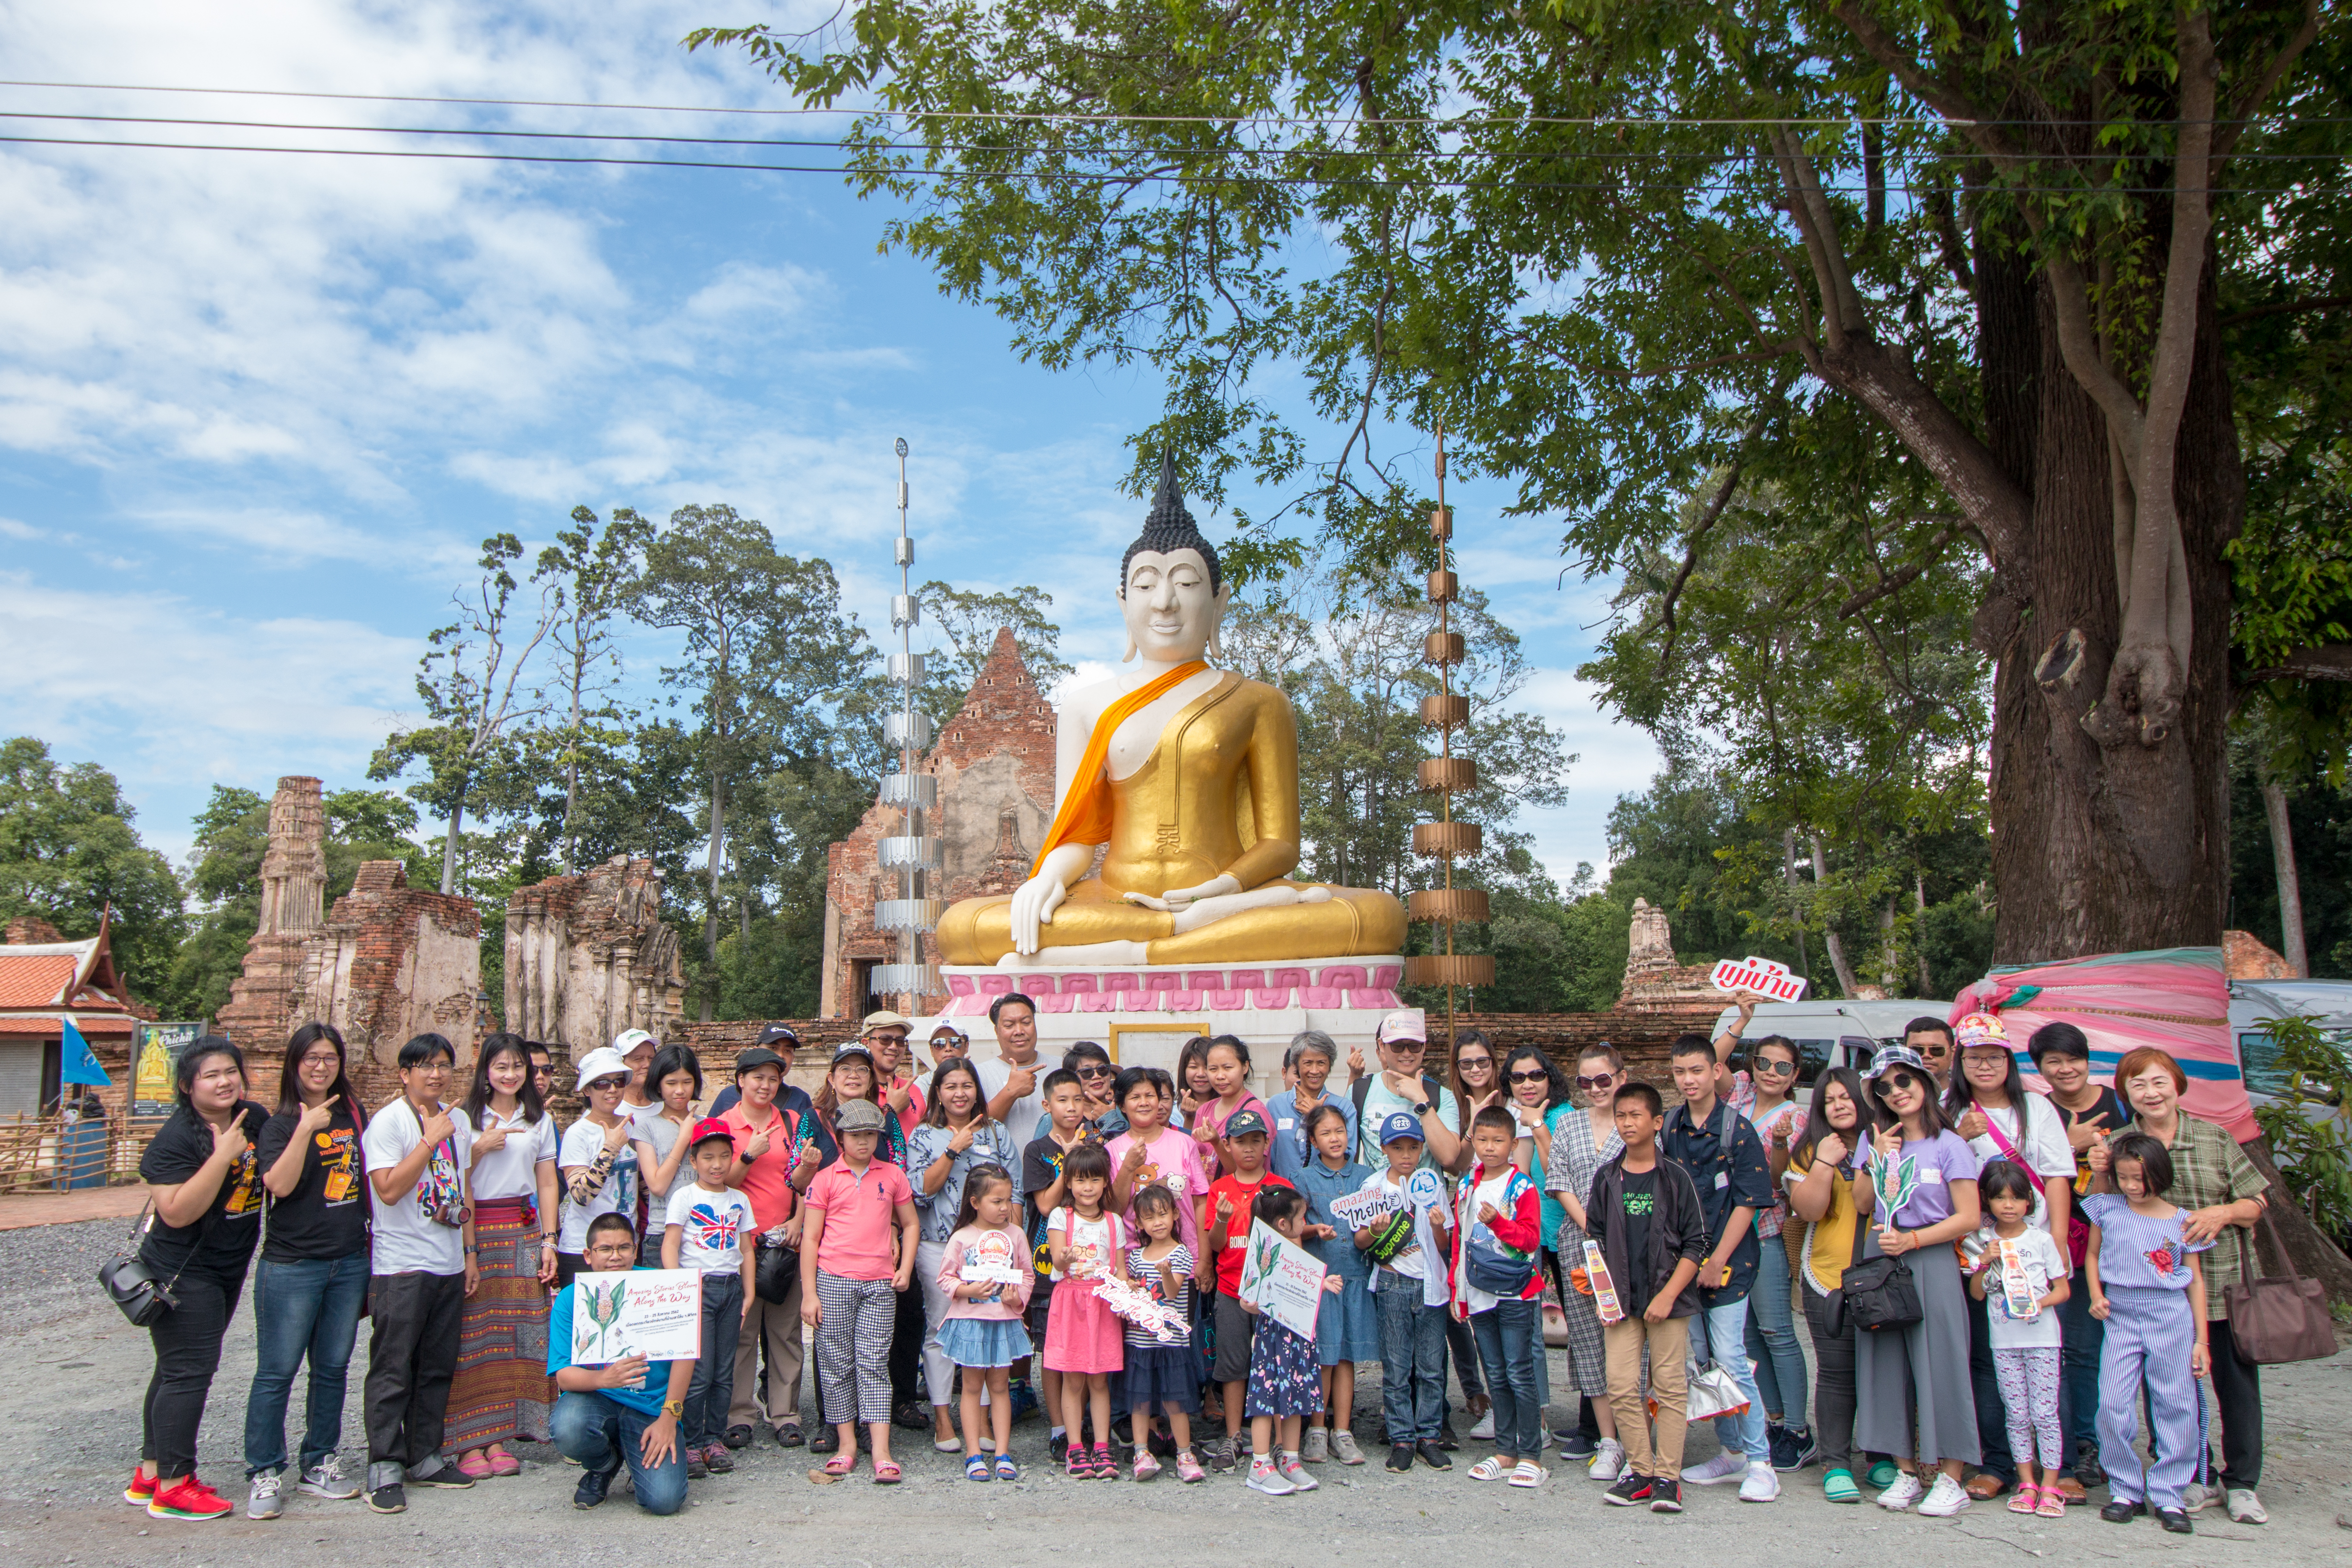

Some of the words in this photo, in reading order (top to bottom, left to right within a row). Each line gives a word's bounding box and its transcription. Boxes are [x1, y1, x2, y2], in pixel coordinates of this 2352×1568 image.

[1716, 959, 1799, 999] แม่บ้าน
[157, 1030, 195, 1046] Phichit
[806, 1187, 812, 1199] 3
[1333, 1187, 1382, 1212] amazing
[980, 1233, 992, 1250] GOLDEN
[993, 1233, 1009, 1253] MOUNTAIN
[1230, 1236, 1249, 1249] BOND
[1375, 1221, 1410, 1260] Supreme
[1279, 1253, 1294, 1267] Amazing
[1295, 1261, 1308, 1272] Stories
[1309, 1268, 1322, 1280] Bloom
[1282, 1264, 1294, 1278] Along
[1303, 1275, 1316, 1289] Way
[627, 1288, 652, 1297] Amazing
[654, 1285, 674, 1294] Stories
[676, 1281, 697, 1290] Bloom
[634, 1296, 655, 1307] Along
[670, 1292, 690, 1303] Way
[1095, 1267, 1130, 1294] Amazing
[1131, 1290, 1160, 1311] Stories
[1163, 1308, 1190, 1334] Bloom
[1094, 1285, 1124, 1310] Along
[1142, 1314, 1172, 1340] Way
